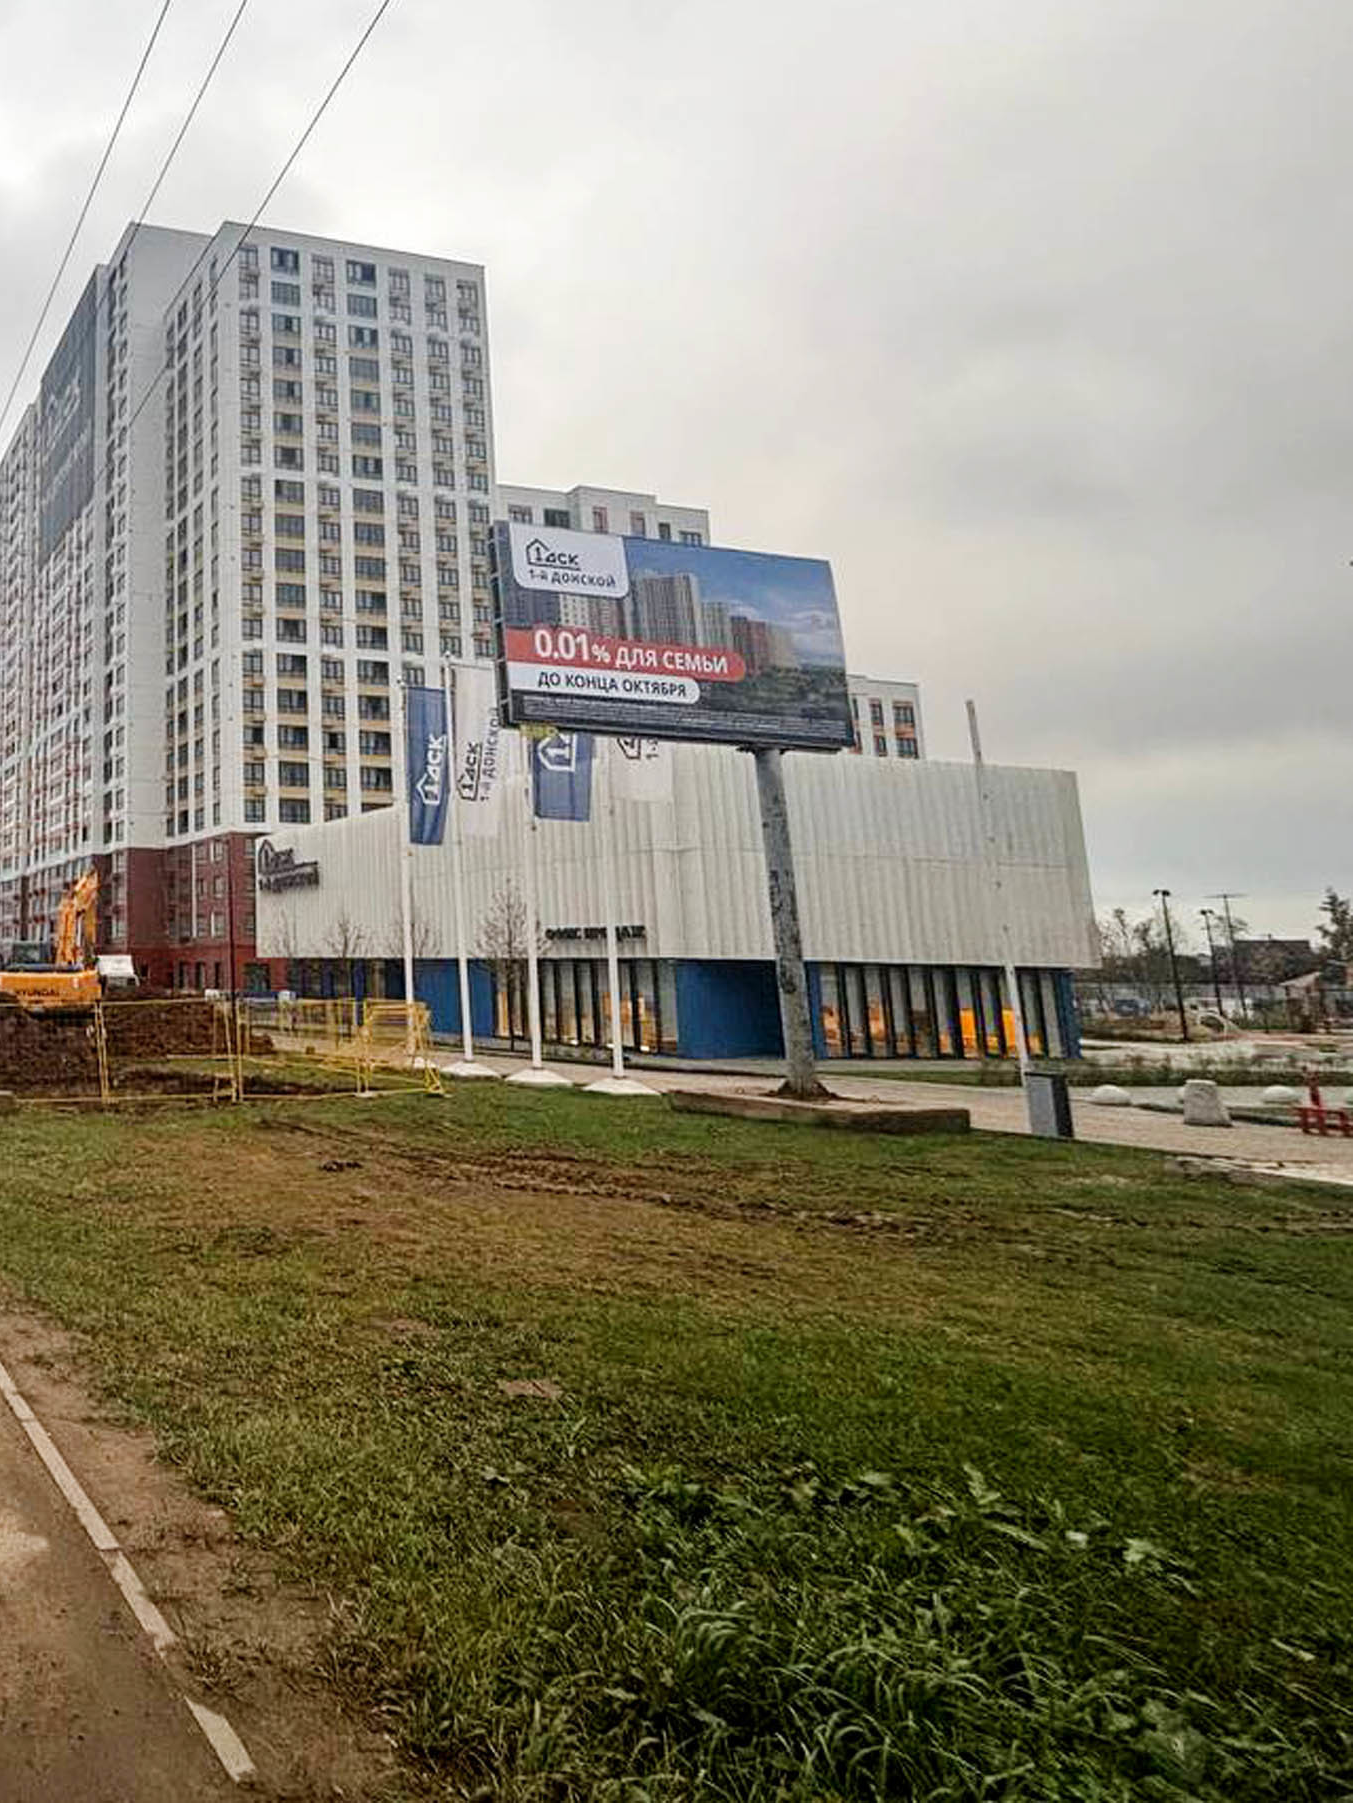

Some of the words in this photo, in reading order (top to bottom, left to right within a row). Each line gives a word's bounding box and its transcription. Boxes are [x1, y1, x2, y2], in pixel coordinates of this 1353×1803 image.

[534, 628, 611, 664] 0.01%
[615, 646, 659, 670] ДЛЯ
[662, 650, 729, 675] СЕМЬИ
[538, 670, 562, 687] ДО
[565, 673, 619, 693] КОНЦА
[623, 679, 687, 698] ОКТЯБРЯ
